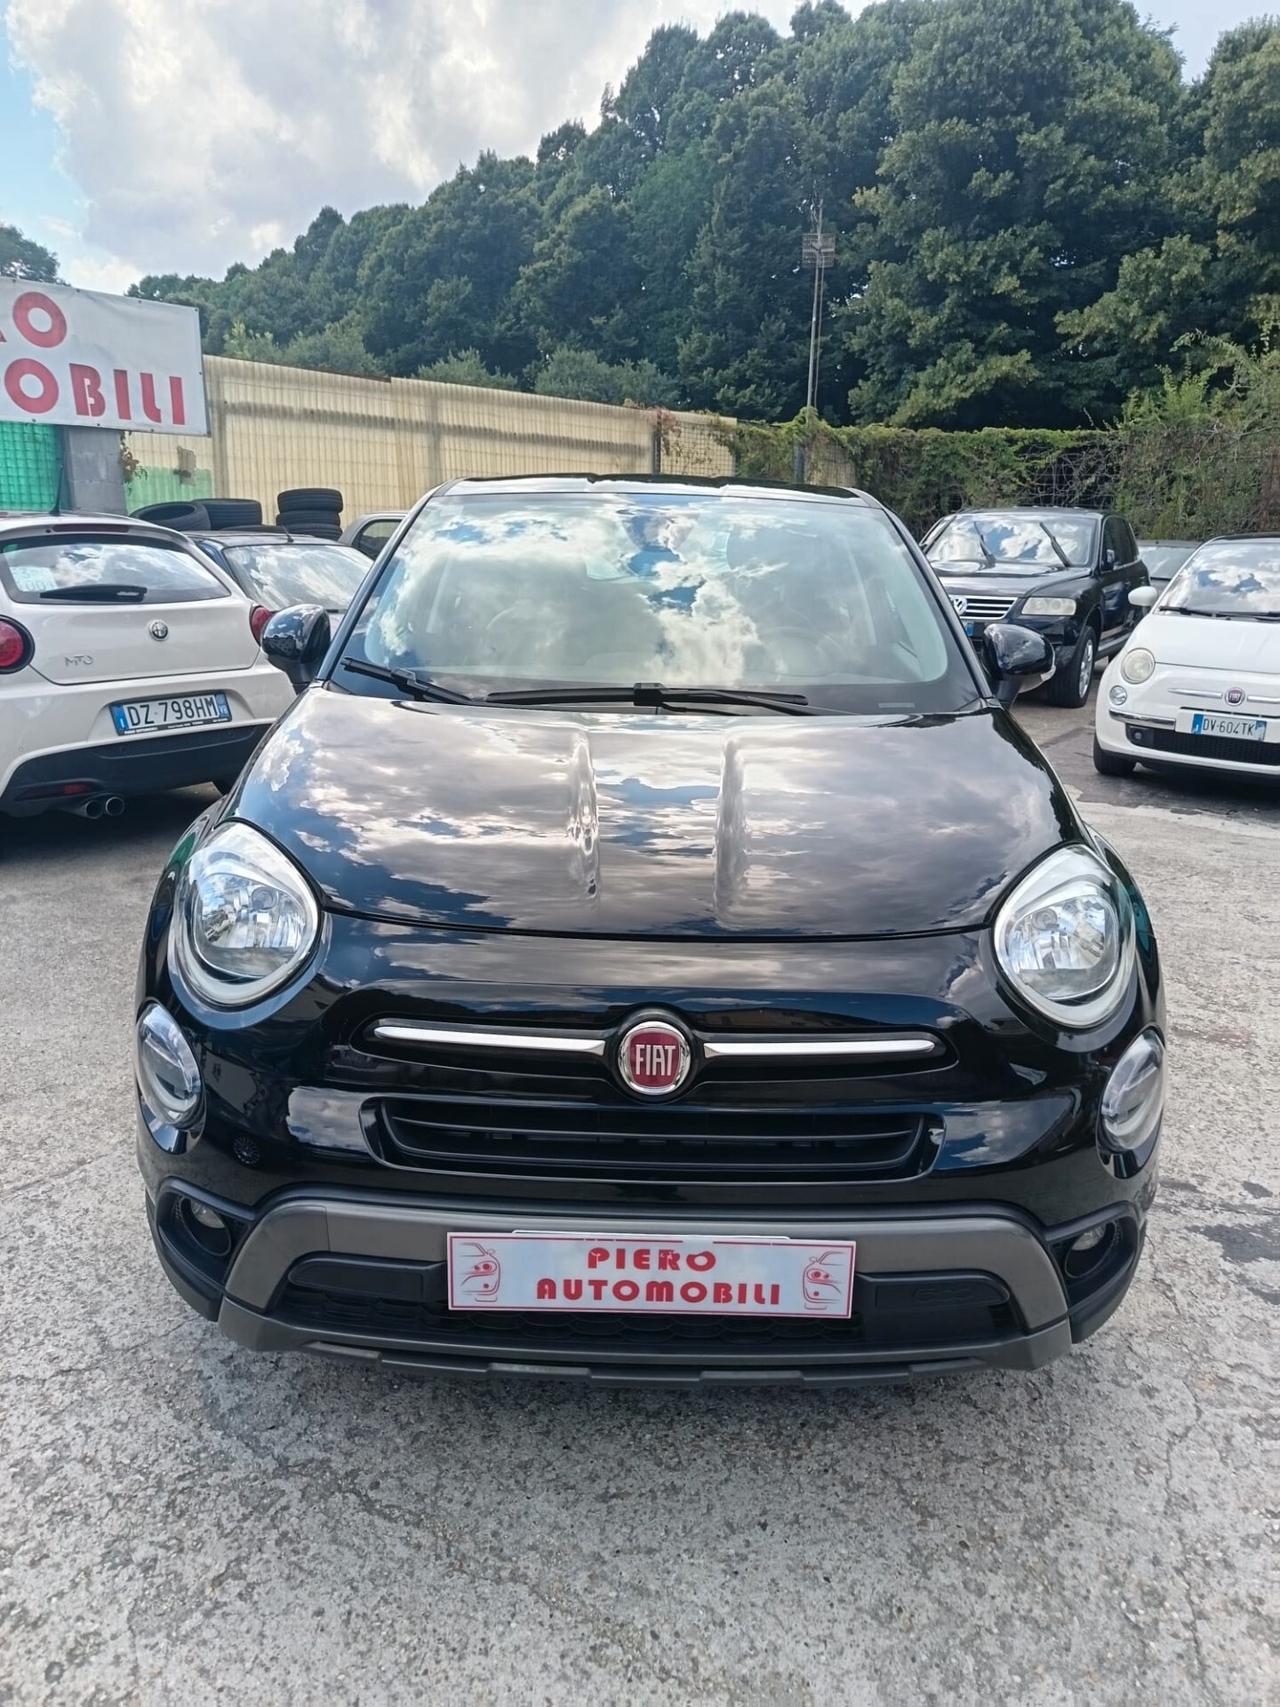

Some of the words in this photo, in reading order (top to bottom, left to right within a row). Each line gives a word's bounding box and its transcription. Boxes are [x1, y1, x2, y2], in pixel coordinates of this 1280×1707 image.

[0, 291, 68, 348] O
[634, 1043, 677, 1077] FIAT
[587, 1247, 717, 1272] PIERO
[536, 1278, 781, 1306] AUTOMOBILI
